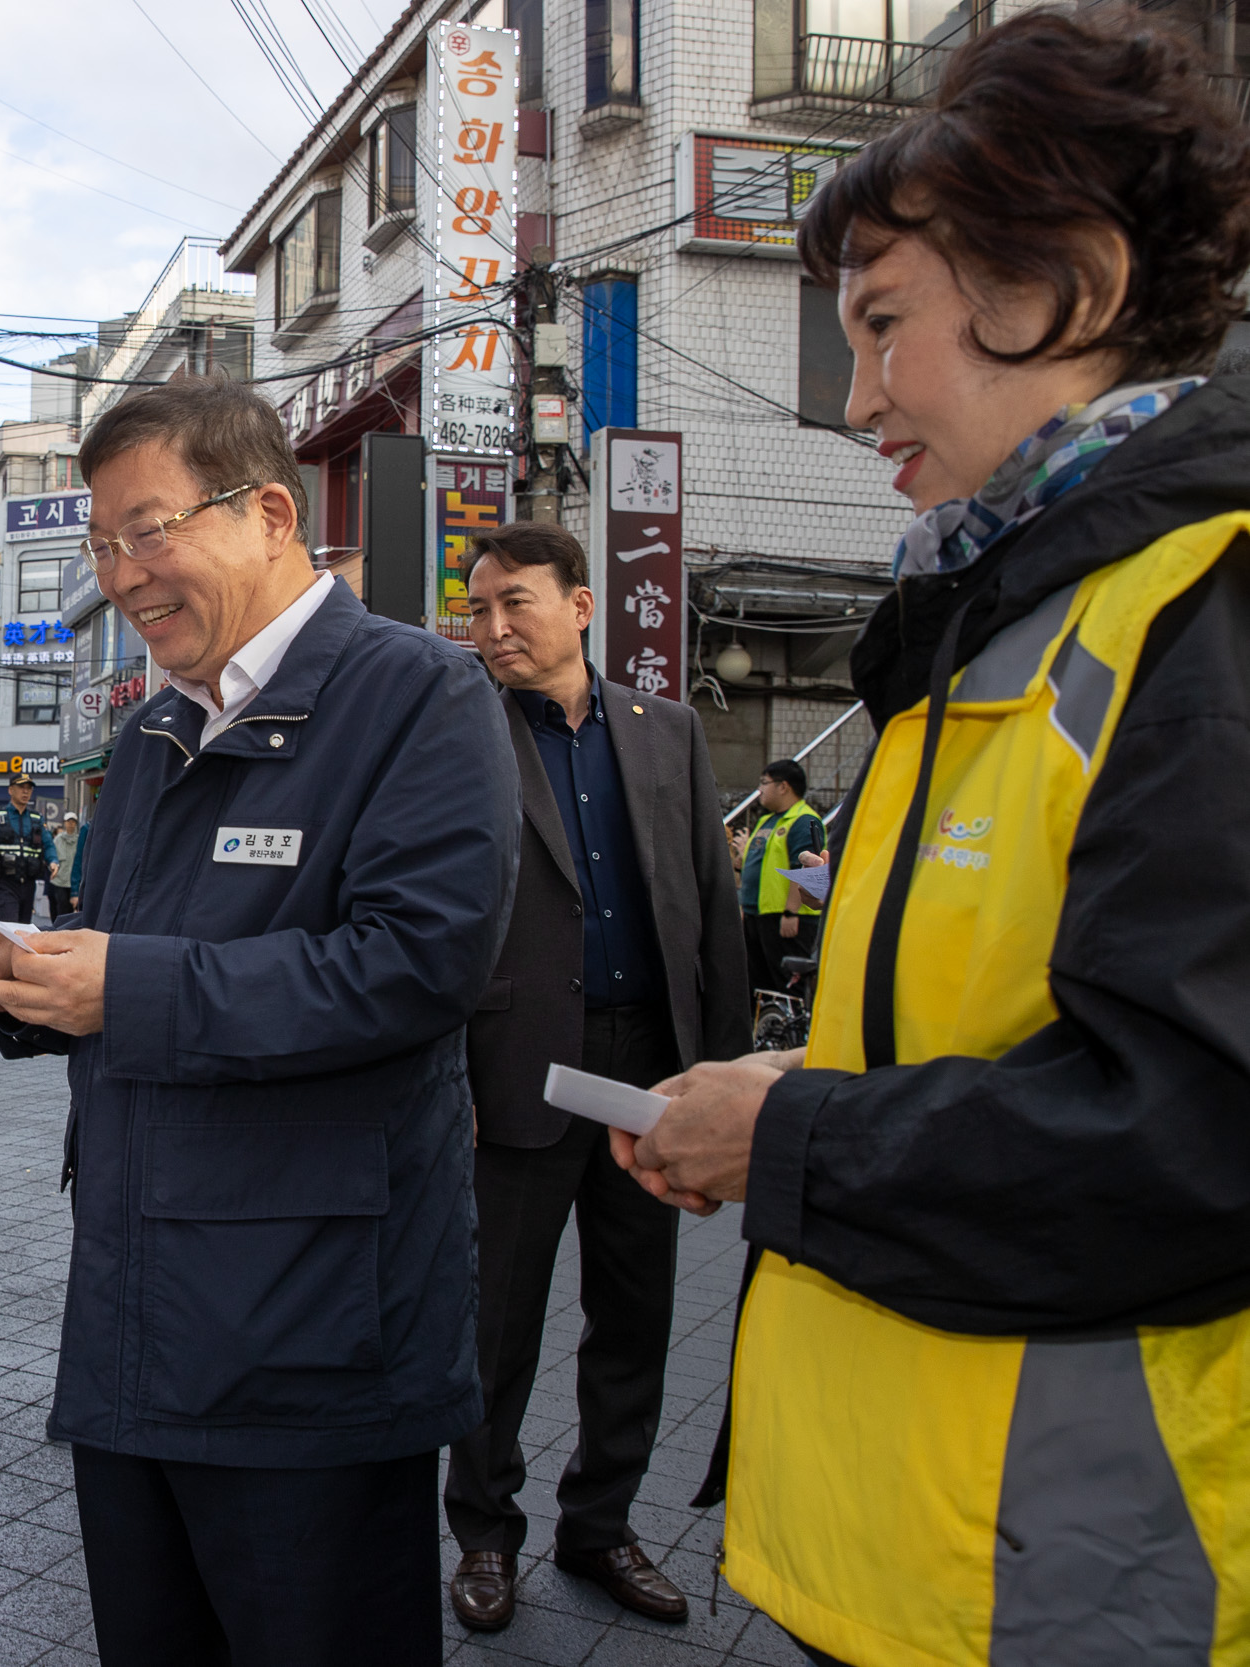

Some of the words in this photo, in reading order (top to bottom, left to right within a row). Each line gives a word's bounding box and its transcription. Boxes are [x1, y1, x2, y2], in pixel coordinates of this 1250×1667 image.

[446, 50, 505, 372] 송화양꼬치
[440, 422, 508, 447] 462-7826
[436, 466, 505, 492] 즐거운
[18, 497, 90, 526] 고시원
[11, 756, 60, 773] emart
